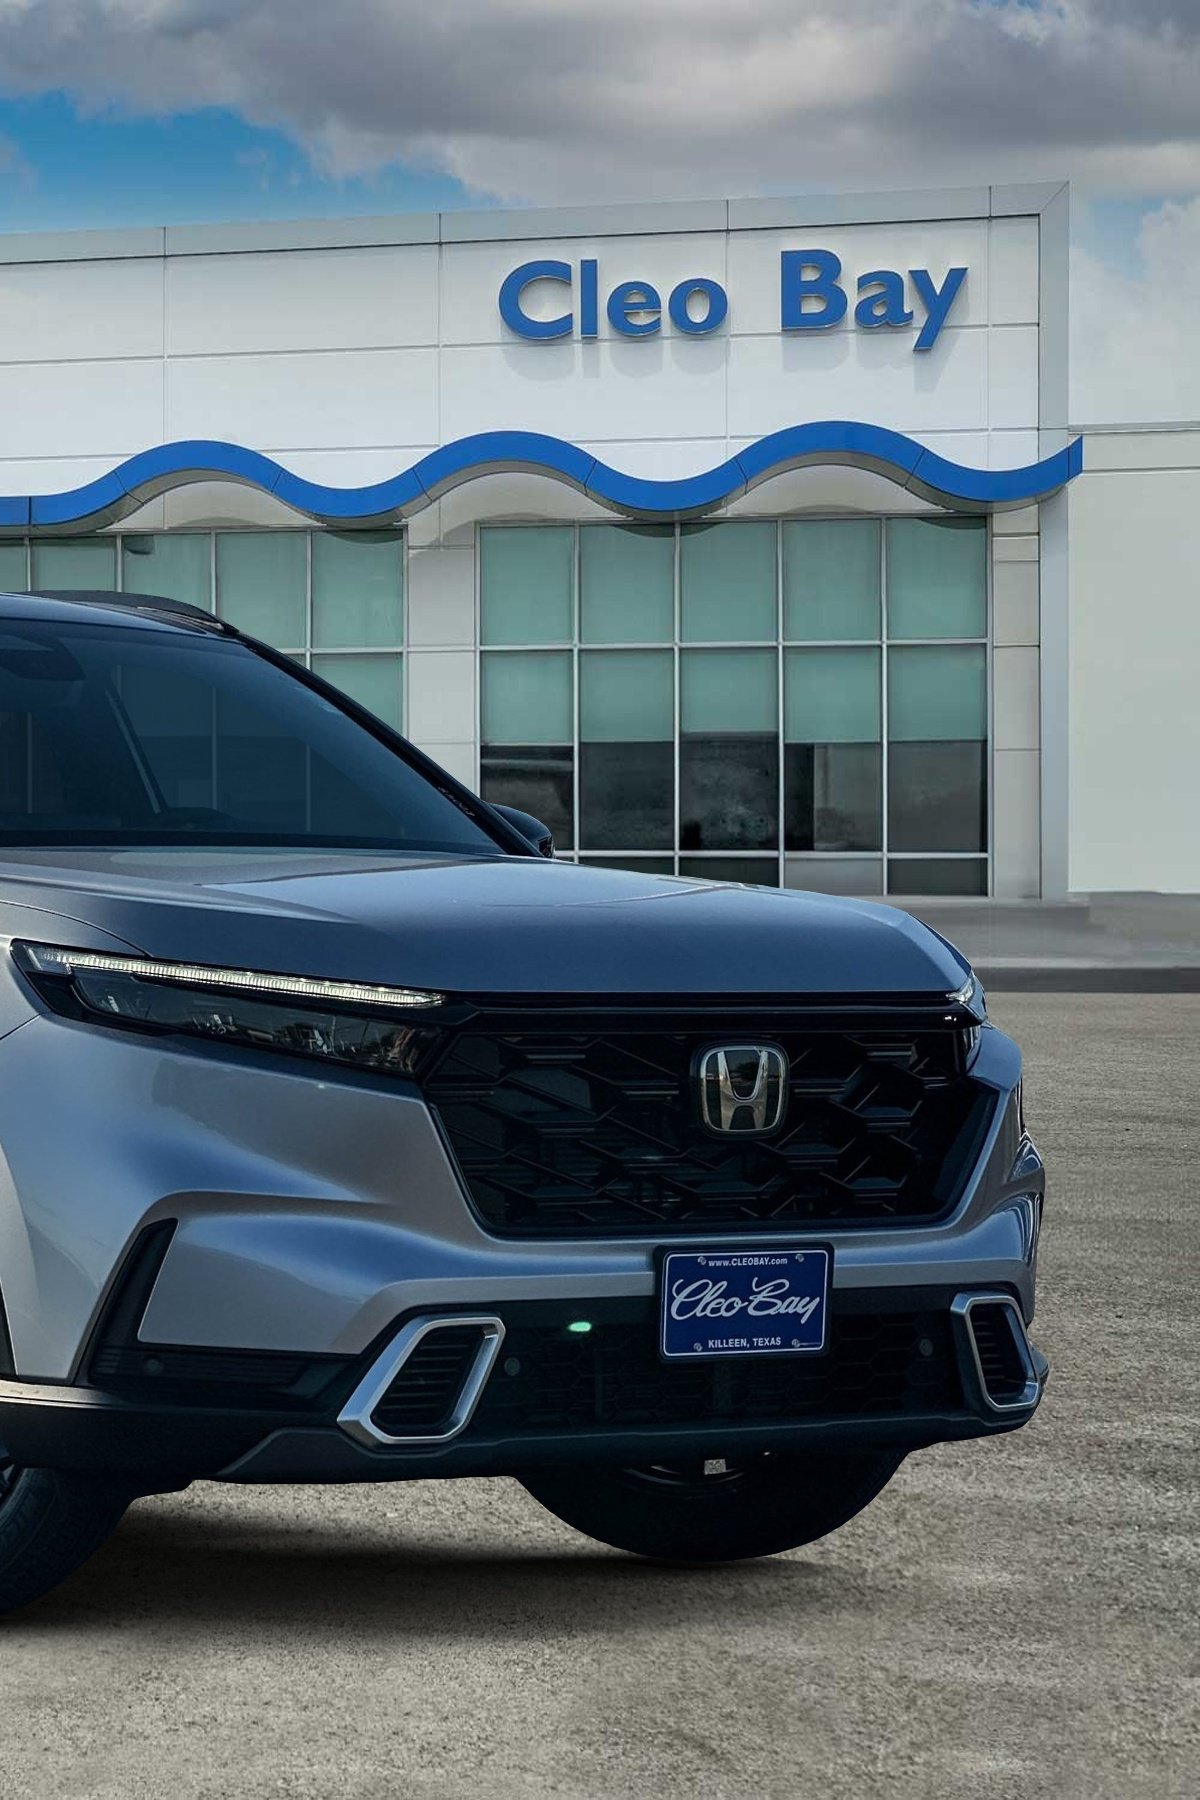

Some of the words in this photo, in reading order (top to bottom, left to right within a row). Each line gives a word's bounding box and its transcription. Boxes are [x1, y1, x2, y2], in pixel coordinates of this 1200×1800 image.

[498, 259, 729, 340] Cleo
[780, 248, 969, 352] Bay
[708, 1257, 788, 1267] www.CLEOBAY.com
[670, 1278, 748, 1321] Cleo
[748, 1277, 821, 1324] Bay
[708, 1338, 750, 1349] KILLEEN,
[752, 1337, 782, 1347] TEXAS
